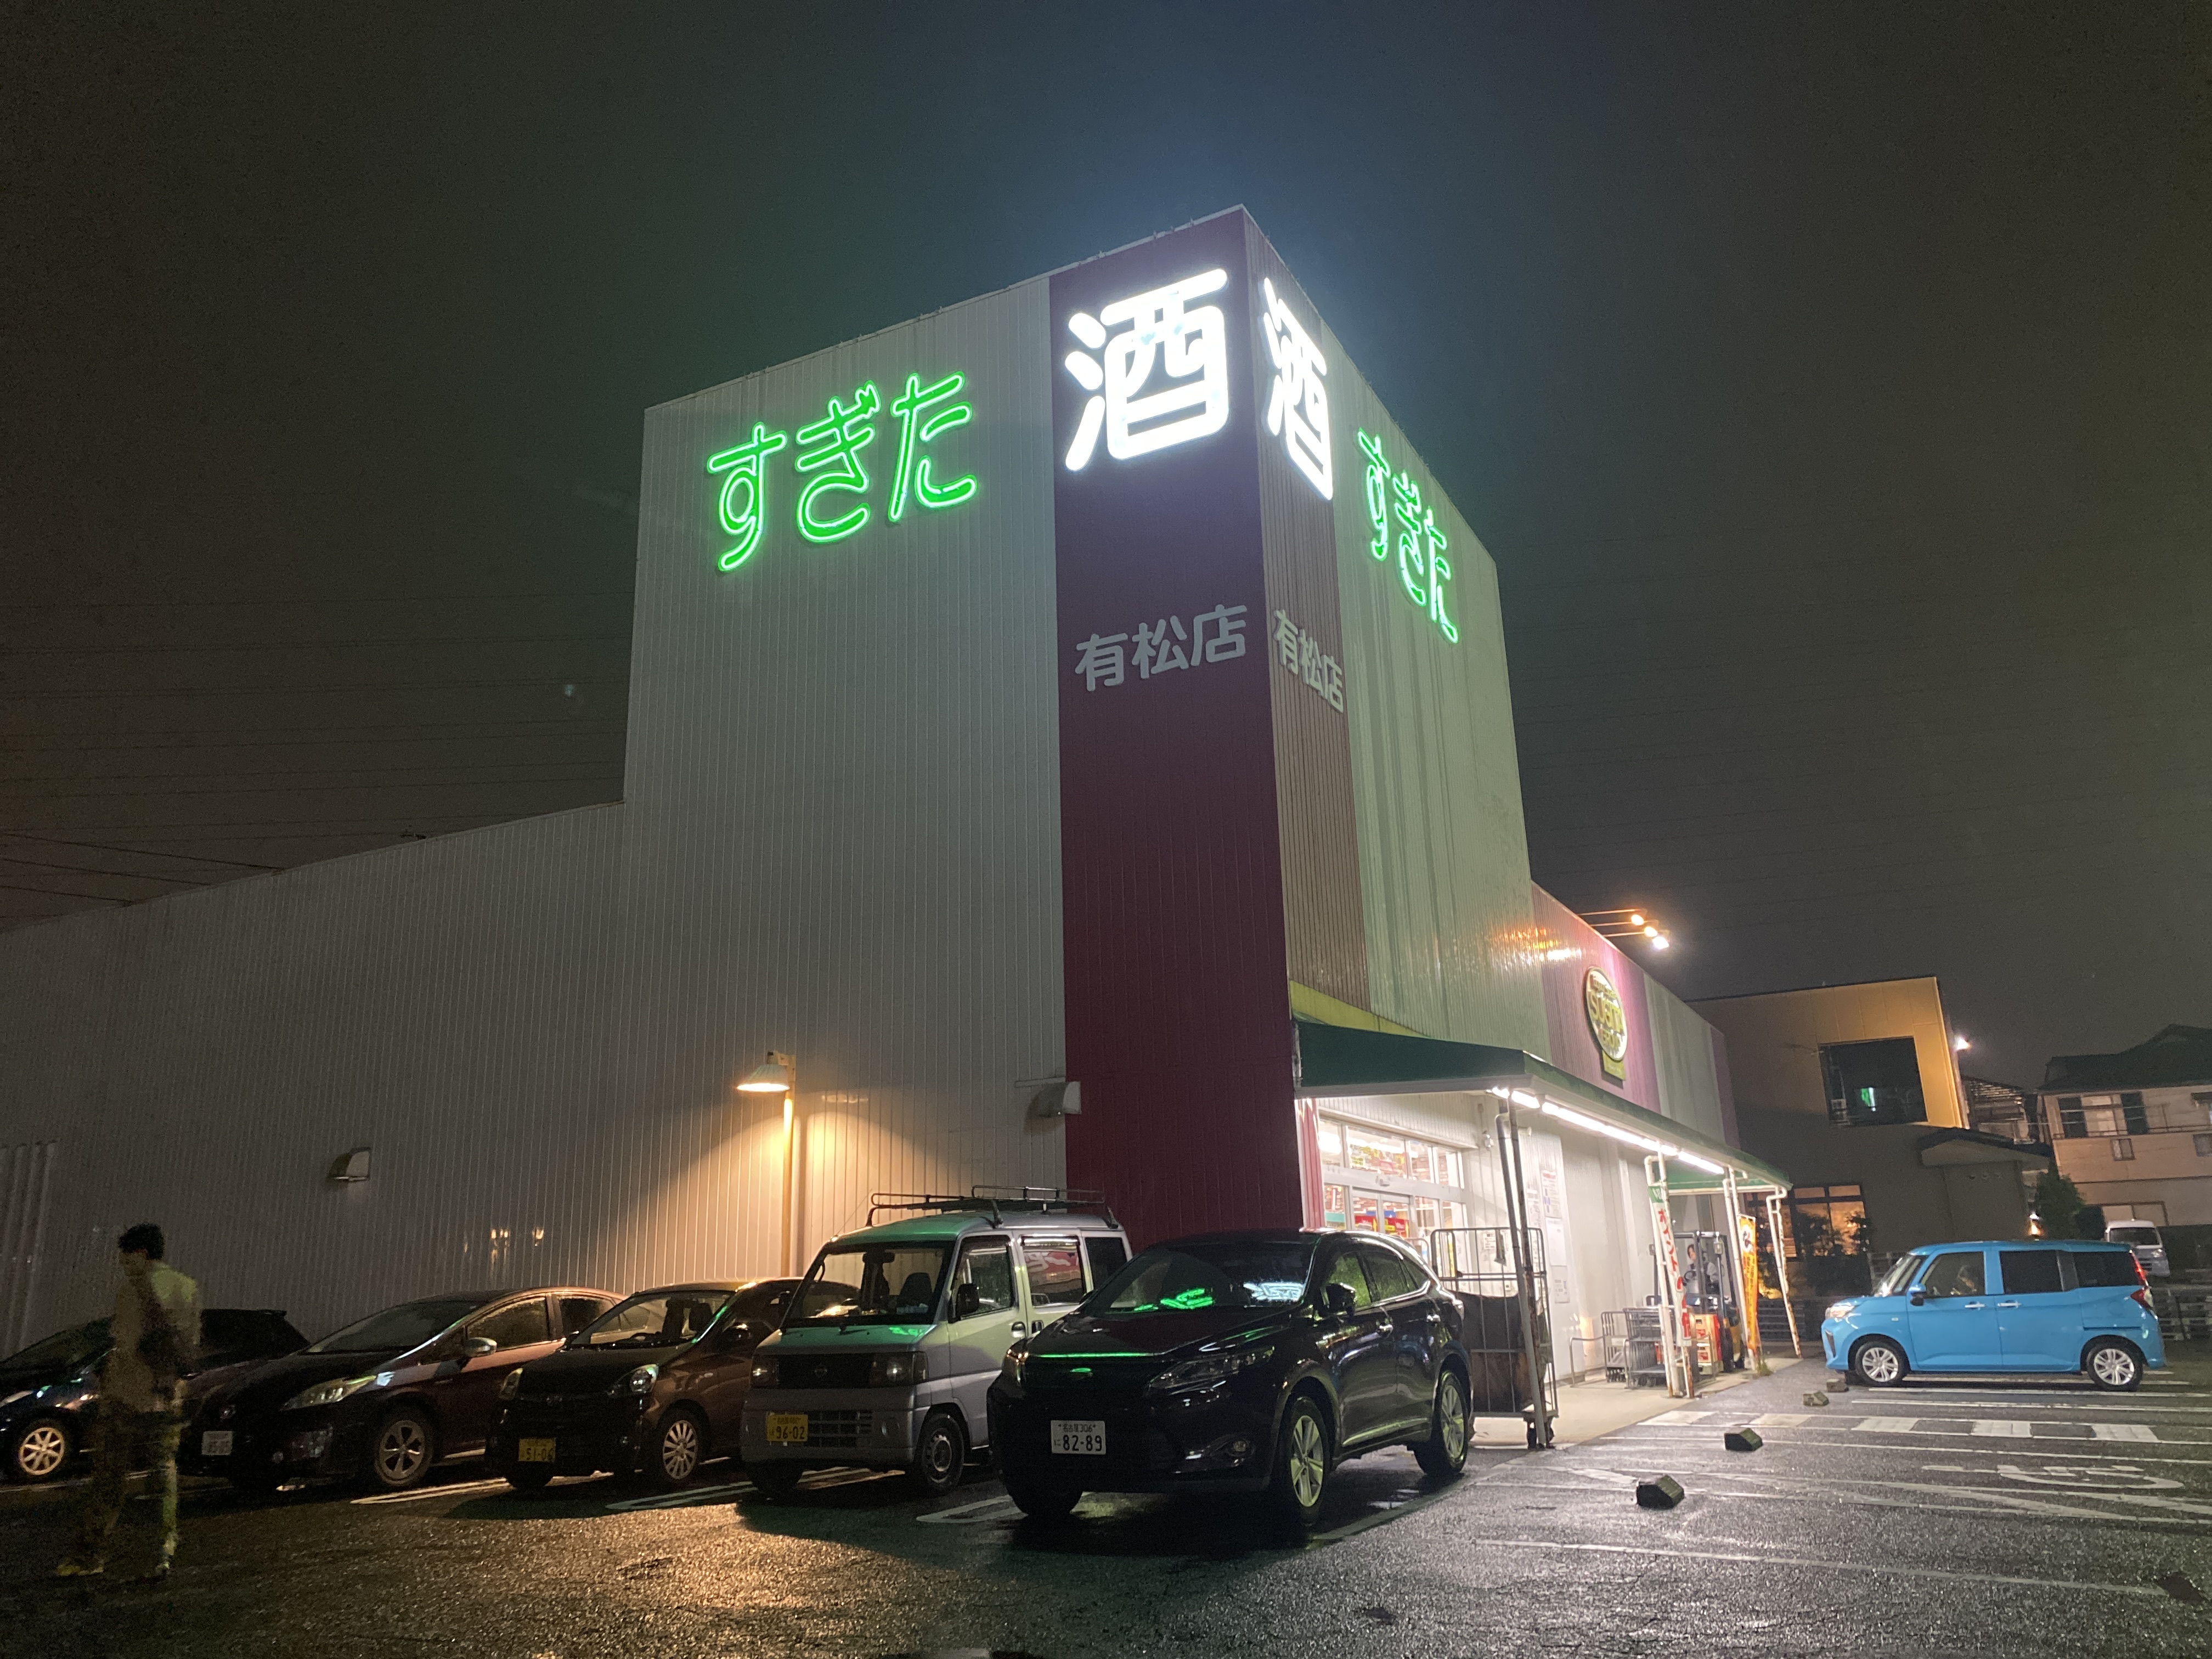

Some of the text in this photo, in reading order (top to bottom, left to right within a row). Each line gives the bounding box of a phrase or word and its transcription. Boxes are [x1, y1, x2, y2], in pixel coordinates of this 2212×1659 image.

[1065, 268, 1228, 471] 酒
[1263, 277, 1333, 501] 酒
[707, 371, 977, 571] すぎた
[1358, 428, 1459, 644] すぎた
[1075, 604, 1247, 692] 有松店
[1273, 609, 1344, 714] 有松店
[1063, 1434, 1102, 1452] 82-89
